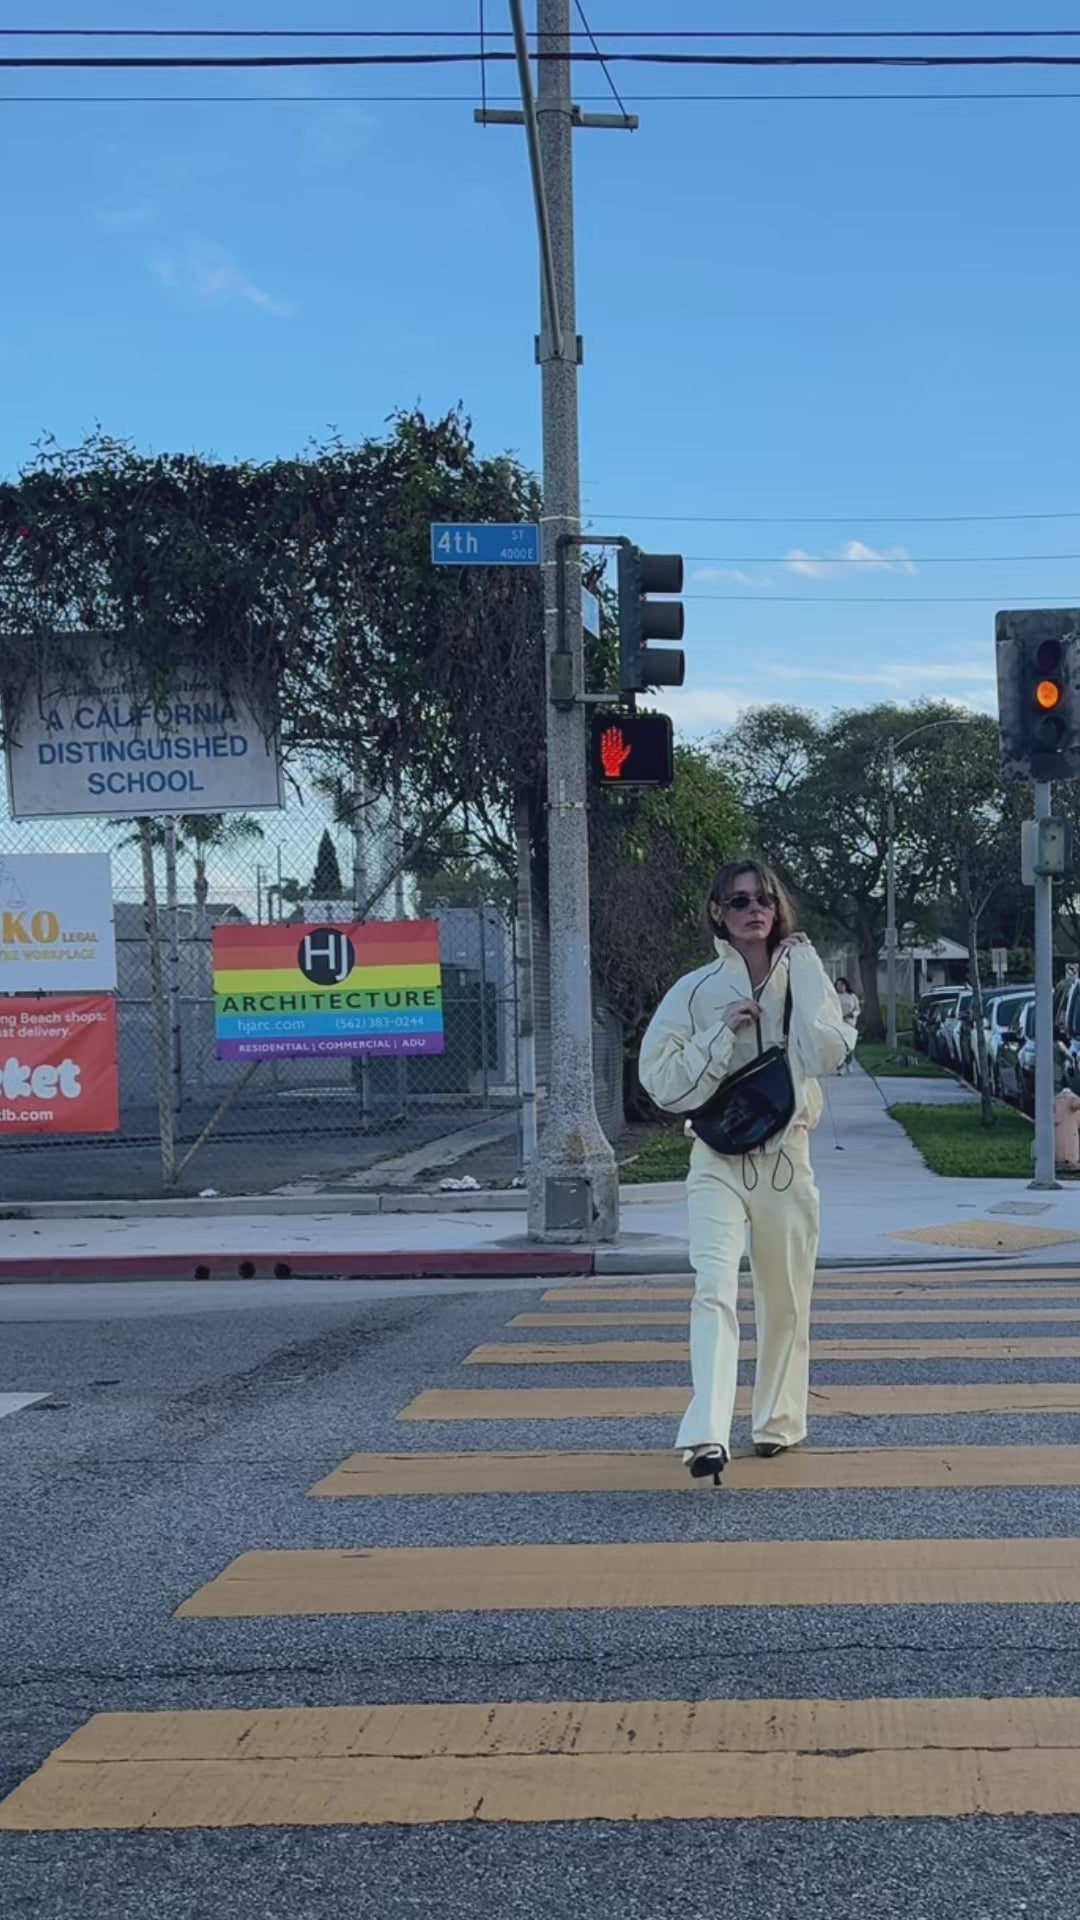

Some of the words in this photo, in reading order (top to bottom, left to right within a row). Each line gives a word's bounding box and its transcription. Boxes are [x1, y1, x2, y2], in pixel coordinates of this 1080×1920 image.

[437, 531, 478, 553] 4th
[511, 529, 524, 541] ST
[500, 548, 533, 559] 4000E
[46, 709, 63, 731] A
[74, 701, 237, 730] CALIFORNIA
[39, 735, 248, 765] DISTINGUISHED
[88, 769, 204, 795] SCHOOL
[62, 931, 98, 943] LEGAL
[304, 933, 348, 981] HJ
[222, 990, 437, 1013] ARCHITECTURE
[20, 1011, 62, 1024] Beach
[238, 1018, 305, 1034] hjarc.com
[239, 1042, 310, 1053] RESIDENTIAL
[402, 1038, 426, 1048] ADU
[0, 1057, 82, 1100] ket
[0, 1108, 54, 1121] lb.com
